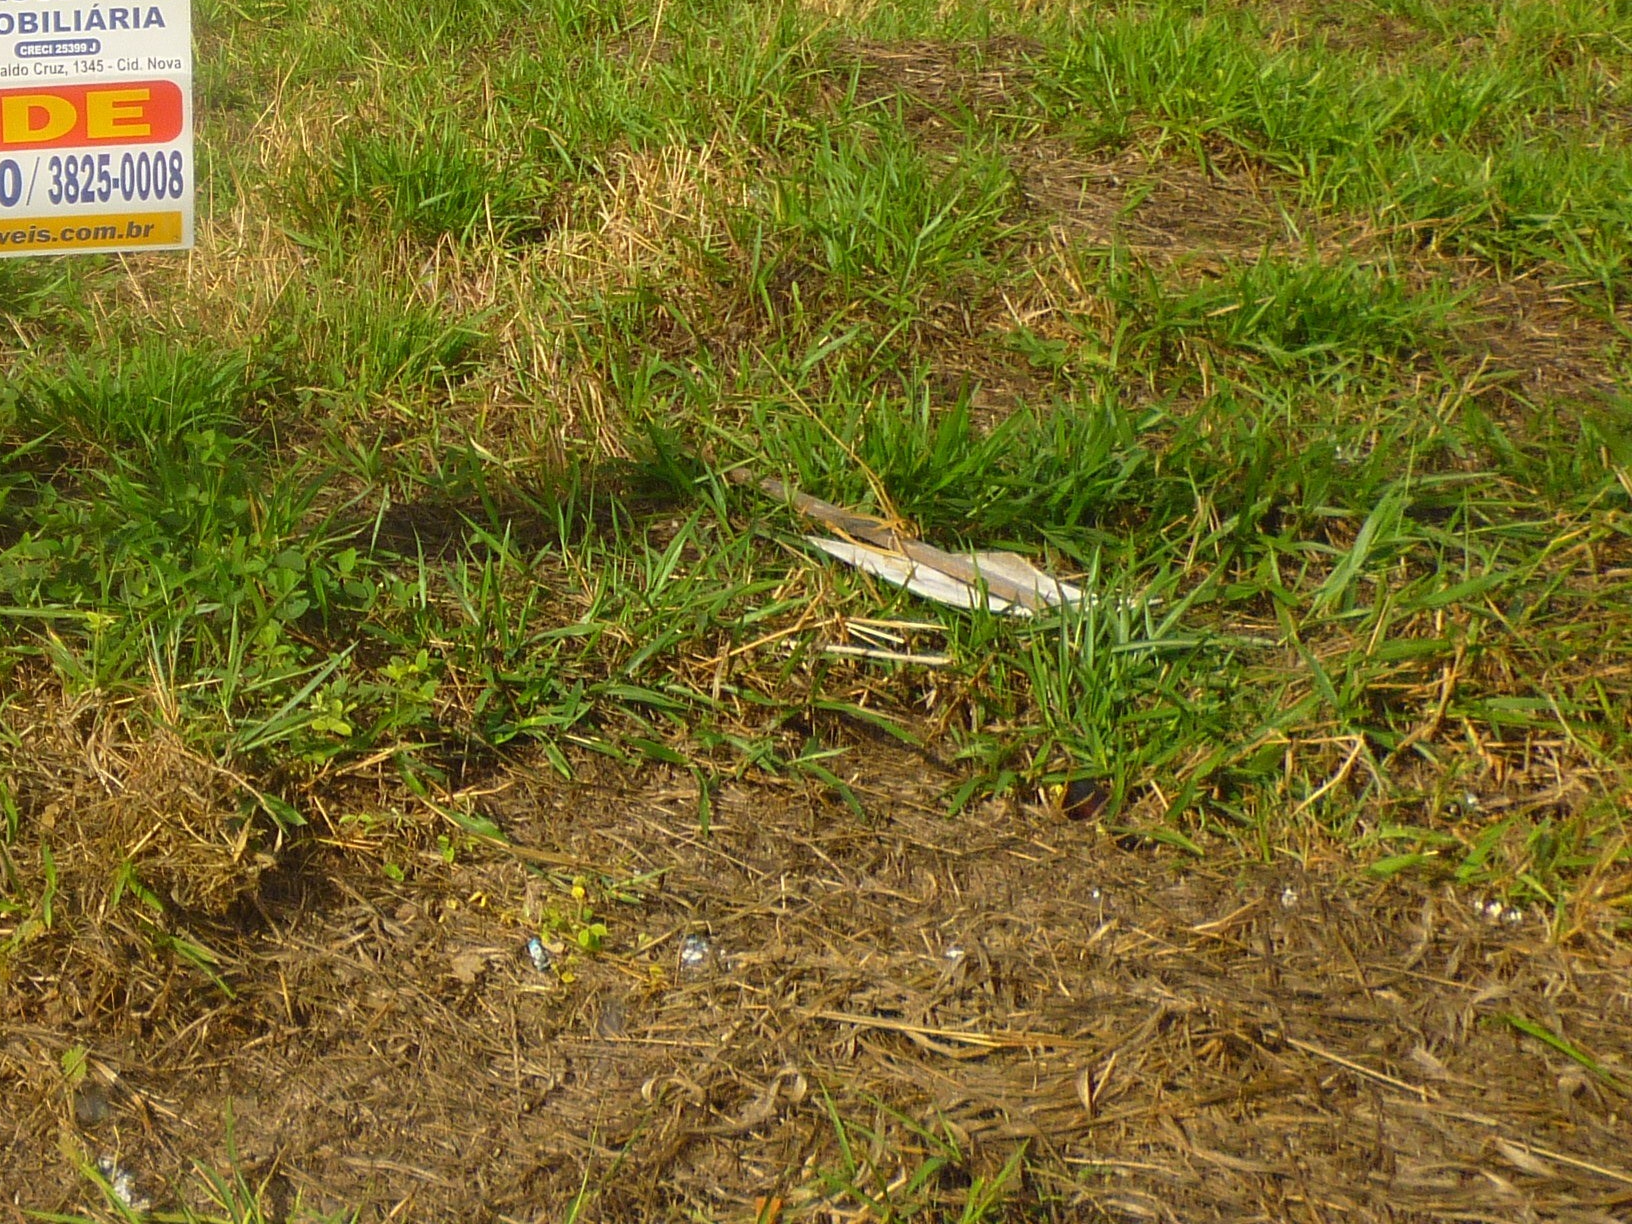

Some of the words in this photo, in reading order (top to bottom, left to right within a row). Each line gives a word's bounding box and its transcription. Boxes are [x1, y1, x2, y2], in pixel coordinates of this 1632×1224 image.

[19, 43, 53, 56] CRECI
[55, 42, 85, 54] 25399
[88, 41, 97, 53] J
[33, 61, 69, 77] Cruz,
[73, 60, 104, 73] 1345
[116, 57, 144, 72] Cid.
[148, 57, 182, 71] Nova
[48, 150, 183, 205] 3825-0008
